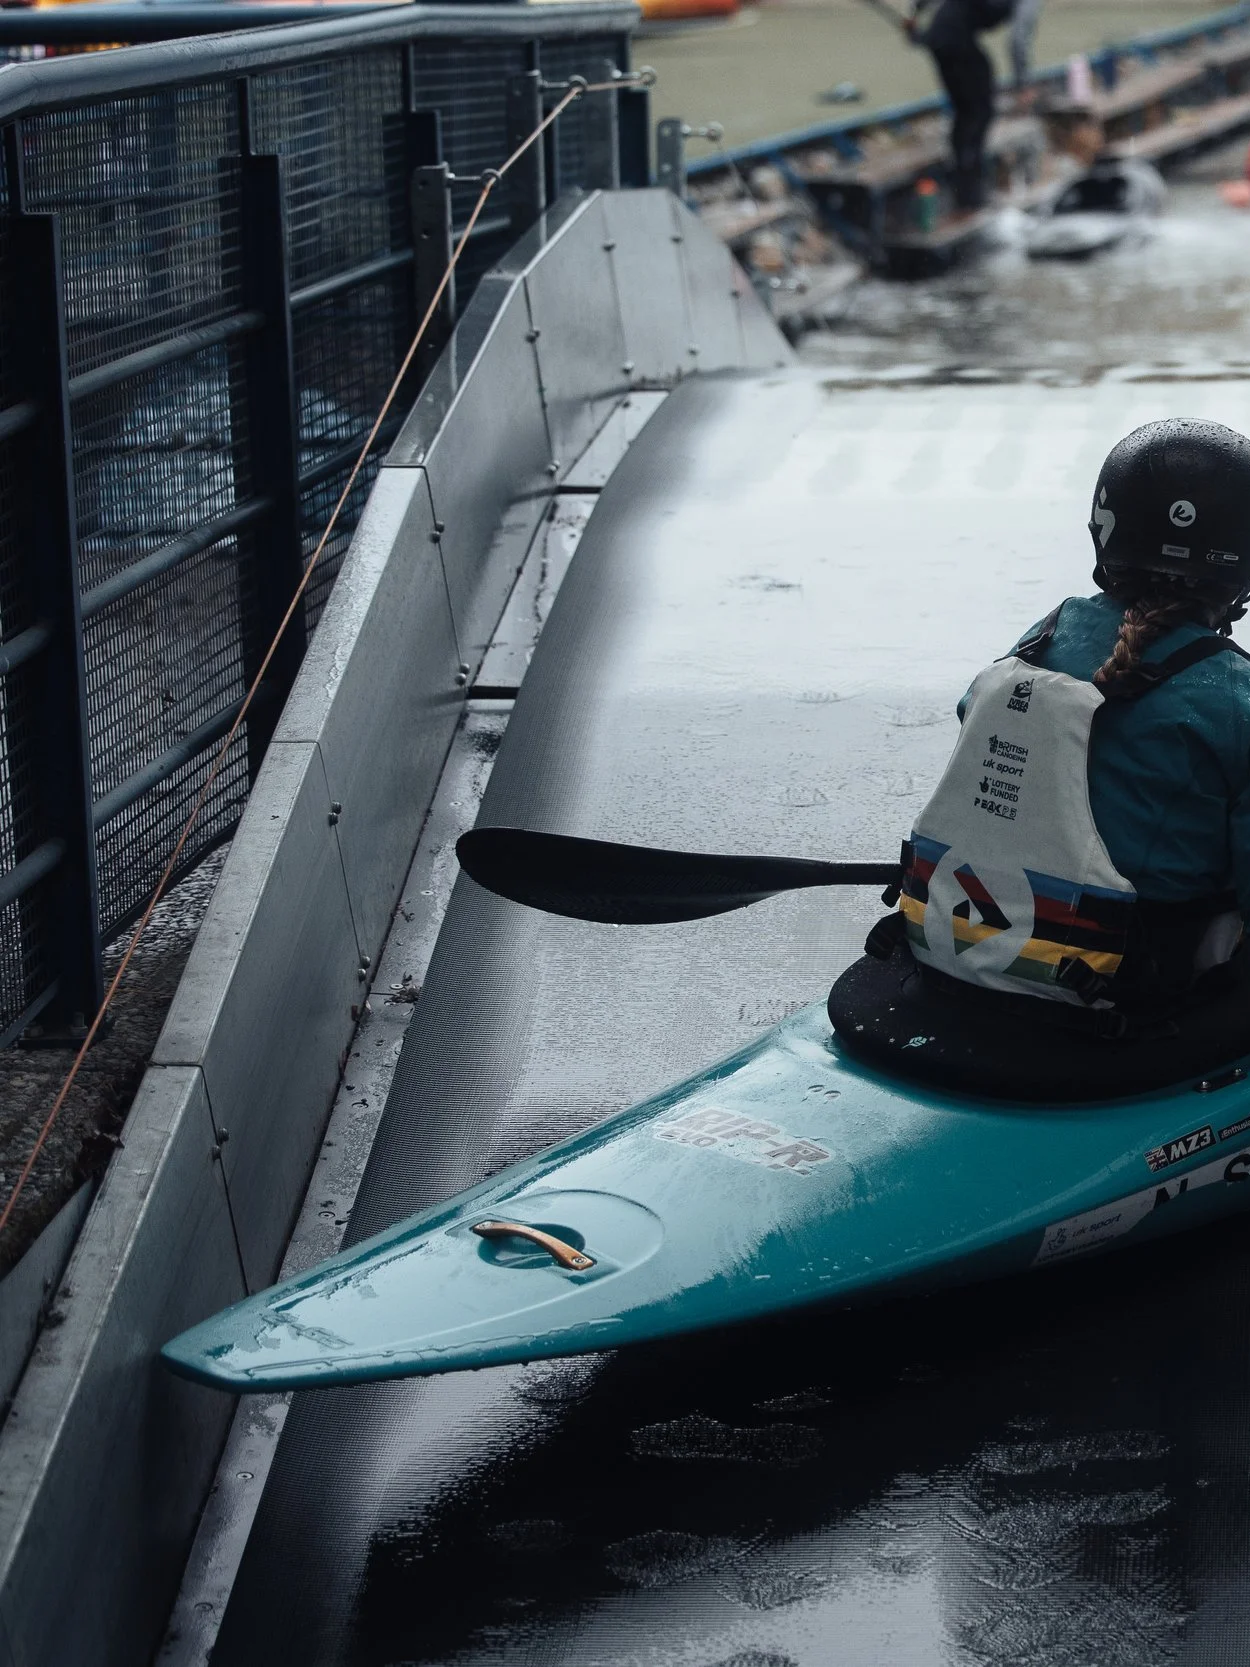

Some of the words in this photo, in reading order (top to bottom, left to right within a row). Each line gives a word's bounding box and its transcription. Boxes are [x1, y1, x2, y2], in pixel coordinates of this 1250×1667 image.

[996, 750, 1027, 763] CANOEING
[998, 741, 1029, 756] BRITISH
[983, 759, 995, 769] uk
[996, 763, 1025, 777] sport
[991, 779, 1021, 793] LOTTERY
[990, 787, 1019, 803] FUNDED
[1170, 1129, 1212, 1161] MZ3
[1090, 1213, 1122, 1231] sport
